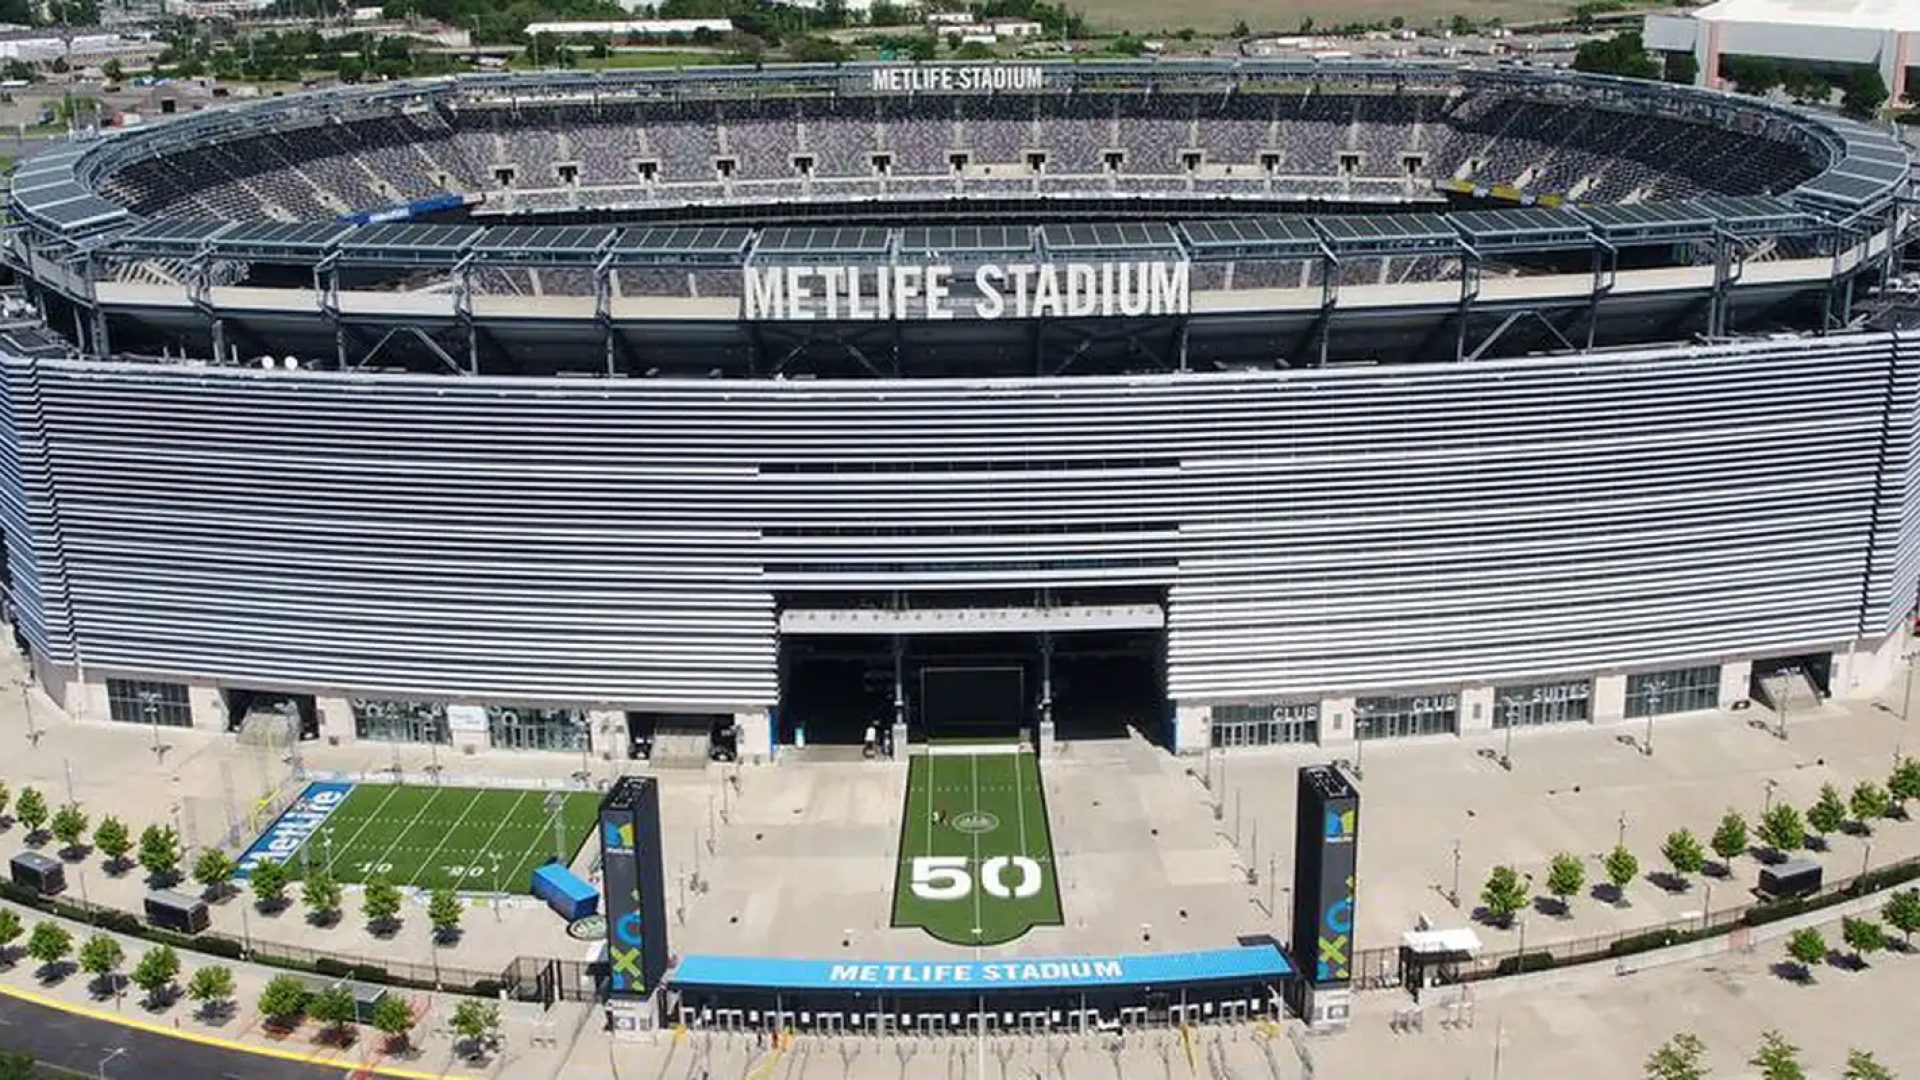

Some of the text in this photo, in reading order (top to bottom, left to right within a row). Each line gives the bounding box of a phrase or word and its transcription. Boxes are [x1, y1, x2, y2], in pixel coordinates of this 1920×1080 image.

[873, 66, 1042, 90] METLIFE STADIUM
[743, 262, 1190, 321] METLIFE STADIUM
[910, 856, 1042, 900] 50
[830, 960, 1123, 981] METLIFE STADIUM
